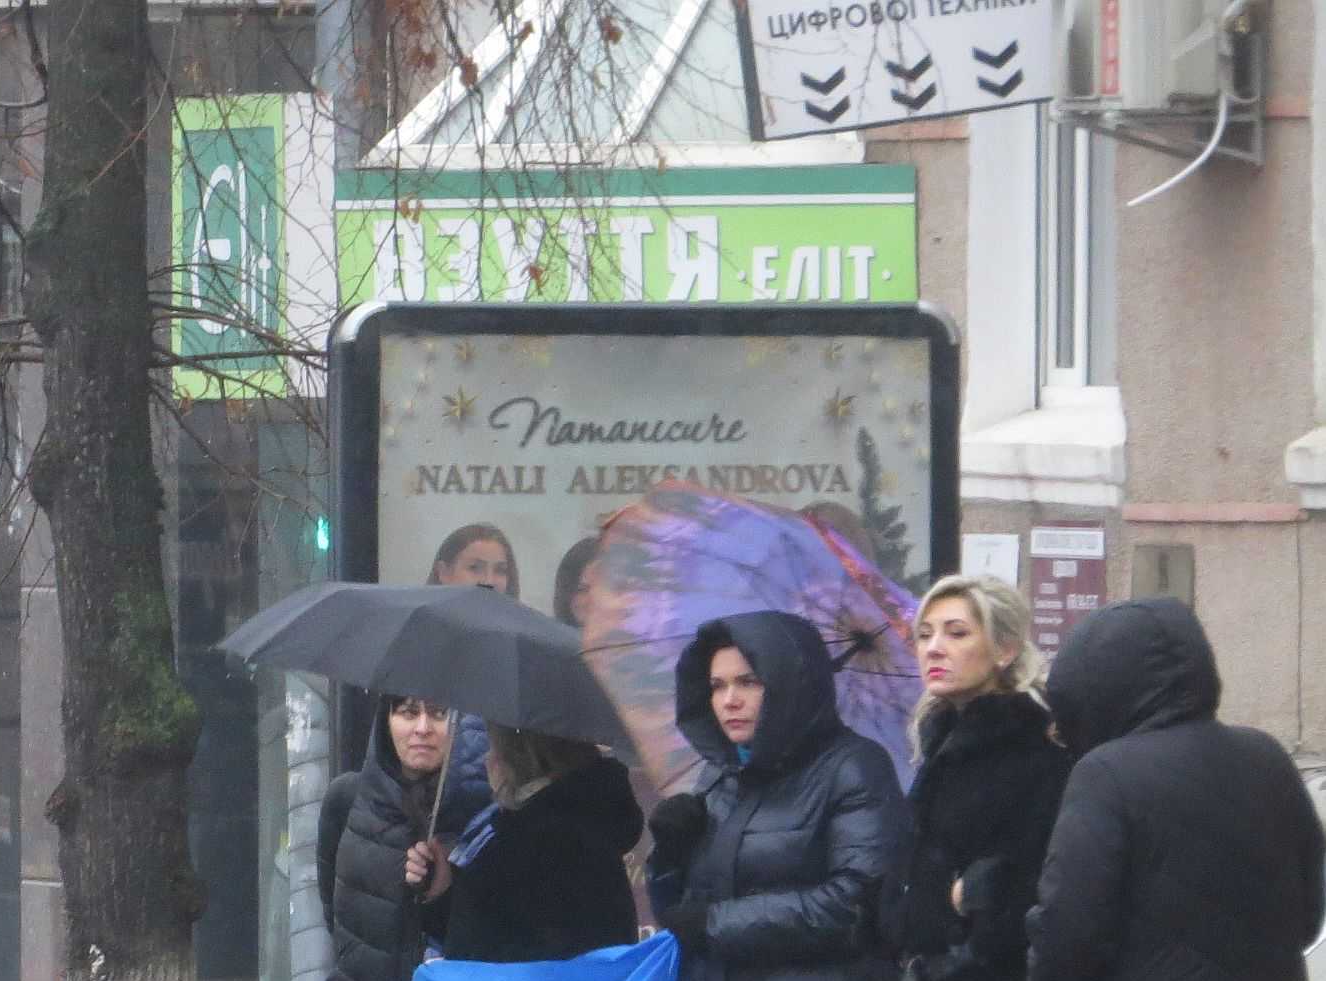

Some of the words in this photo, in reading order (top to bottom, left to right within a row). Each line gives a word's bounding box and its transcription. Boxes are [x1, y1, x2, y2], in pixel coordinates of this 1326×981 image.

[373, 215, 719, 301] ВЗУТТЯ
[488, 395, 747, 449] Namanicure
[415, 464, 547, 496] NATALI
[565, 463, 852, 494] ALEKSANDROVA
